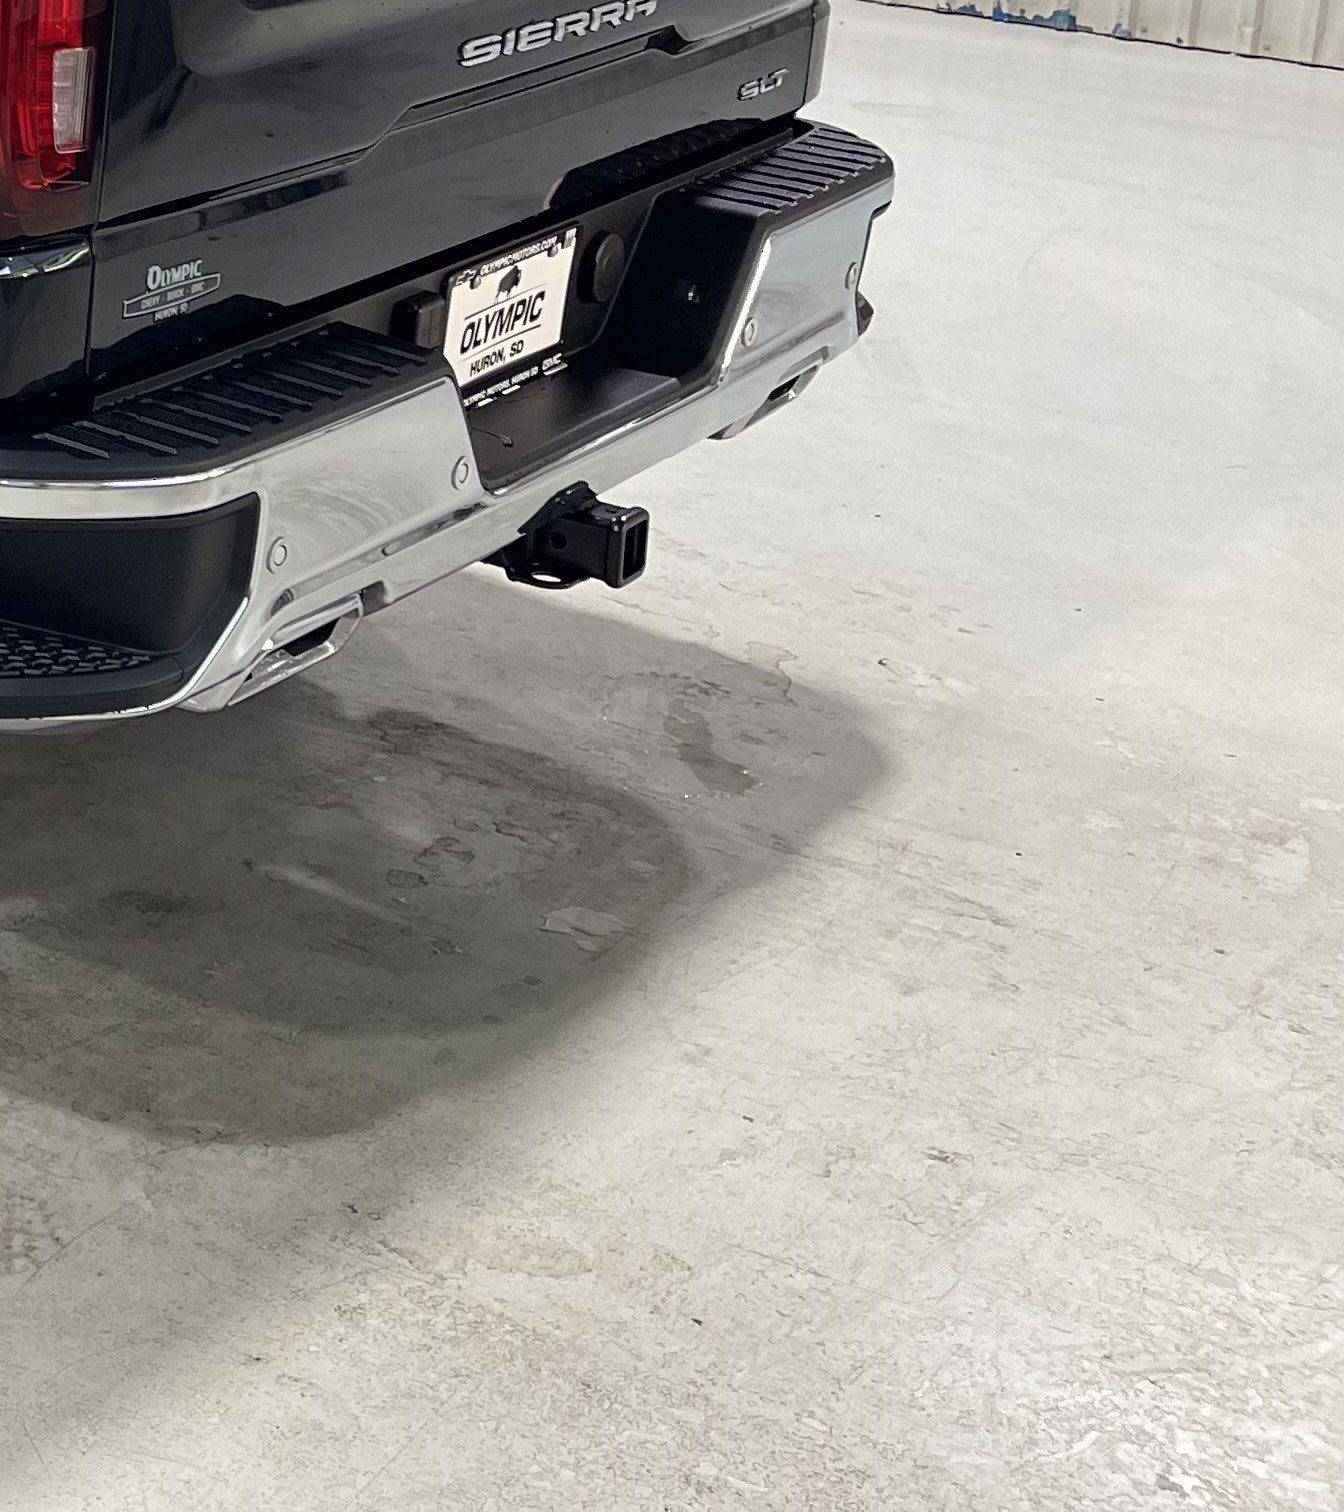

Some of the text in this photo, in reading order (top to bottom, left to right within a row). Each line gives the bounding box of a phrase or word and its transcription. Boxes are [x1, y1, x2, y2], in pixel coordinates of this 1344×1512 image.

[737, 68, 789, 101] SLT
[460, 291, 546, 355] OLYMPIC
[469, 340, 524, 377] HURON, SD
